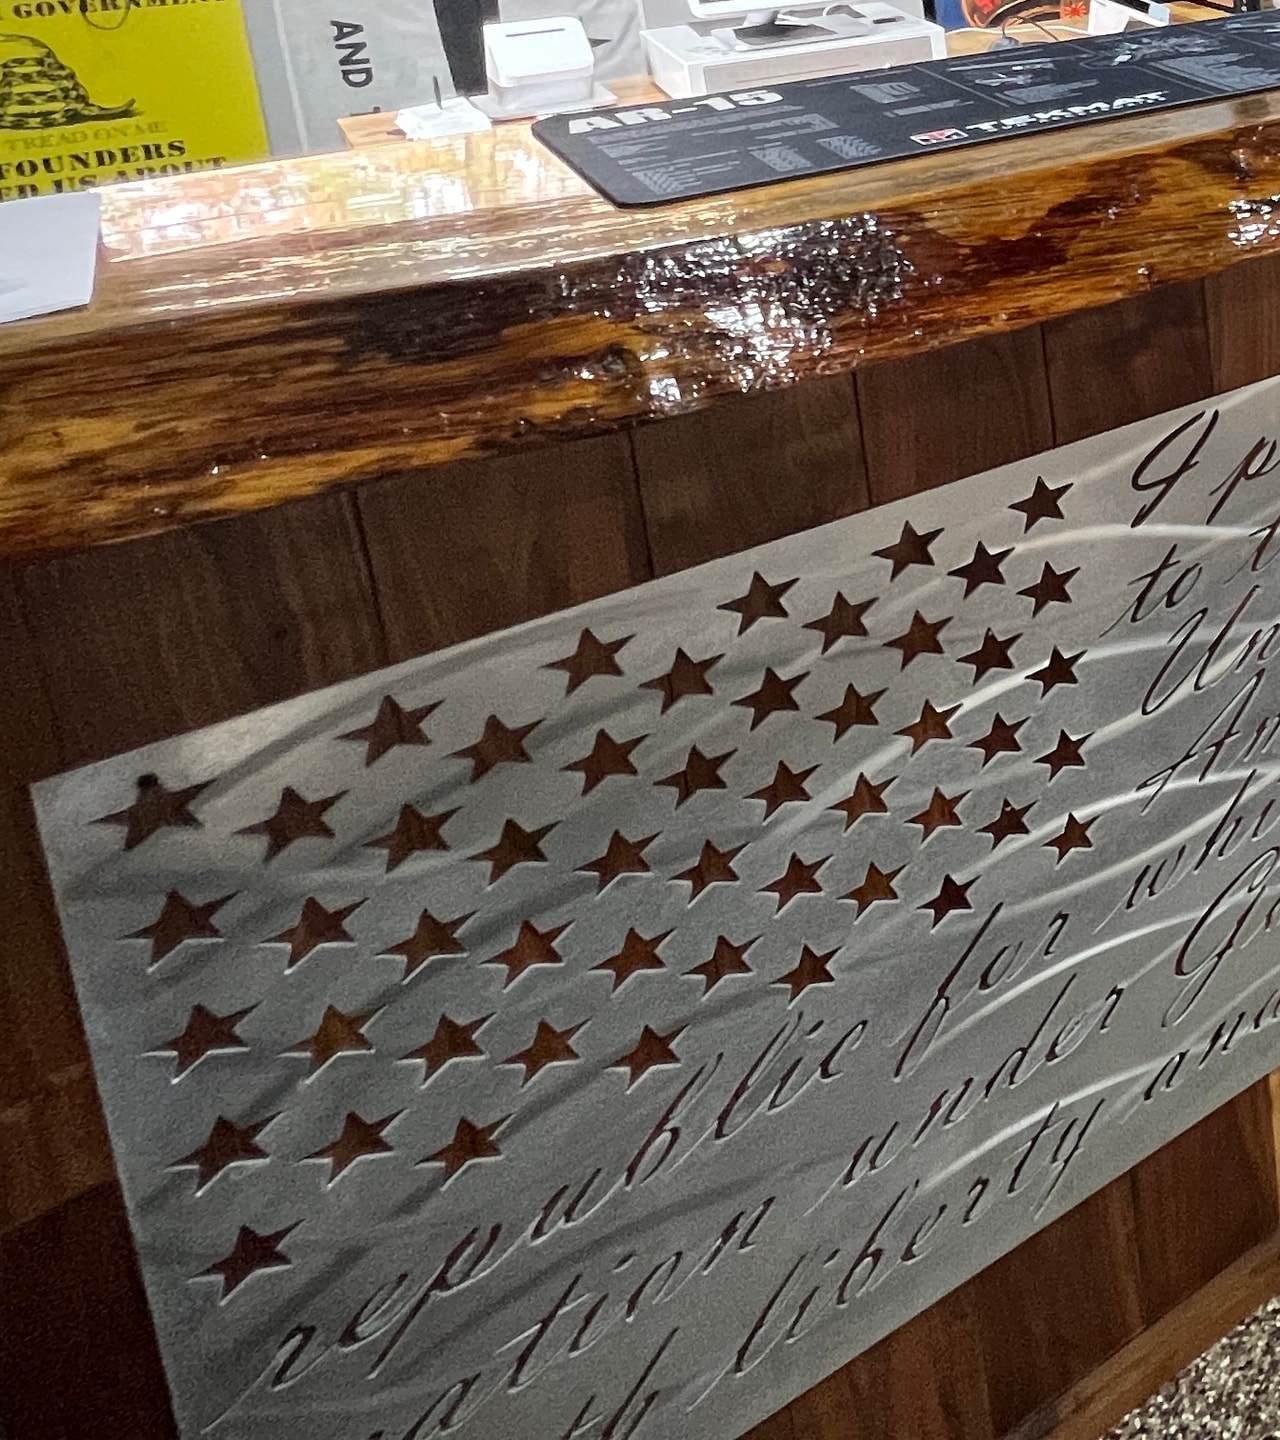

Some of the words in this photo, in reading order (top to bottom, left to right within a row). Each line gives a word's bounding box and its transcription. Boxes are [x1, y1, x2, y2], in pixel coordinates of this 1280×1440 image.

[331, 20, 374, 89] AND
[5, 129, 88, 151] TREAD
[569, 90, 784, 135] AR-15
[0, 140, 187, 180] FOUNDERS
[1101, 544, 1203, 638] to
[212, 1012, 868, 1430] republic
[890, 903, 1073, 1082] for
[366, 1196, 778, 1440] ation
[806, 974, 1129, 1216] under
[690, 1098, 1105, 1410] liberty
